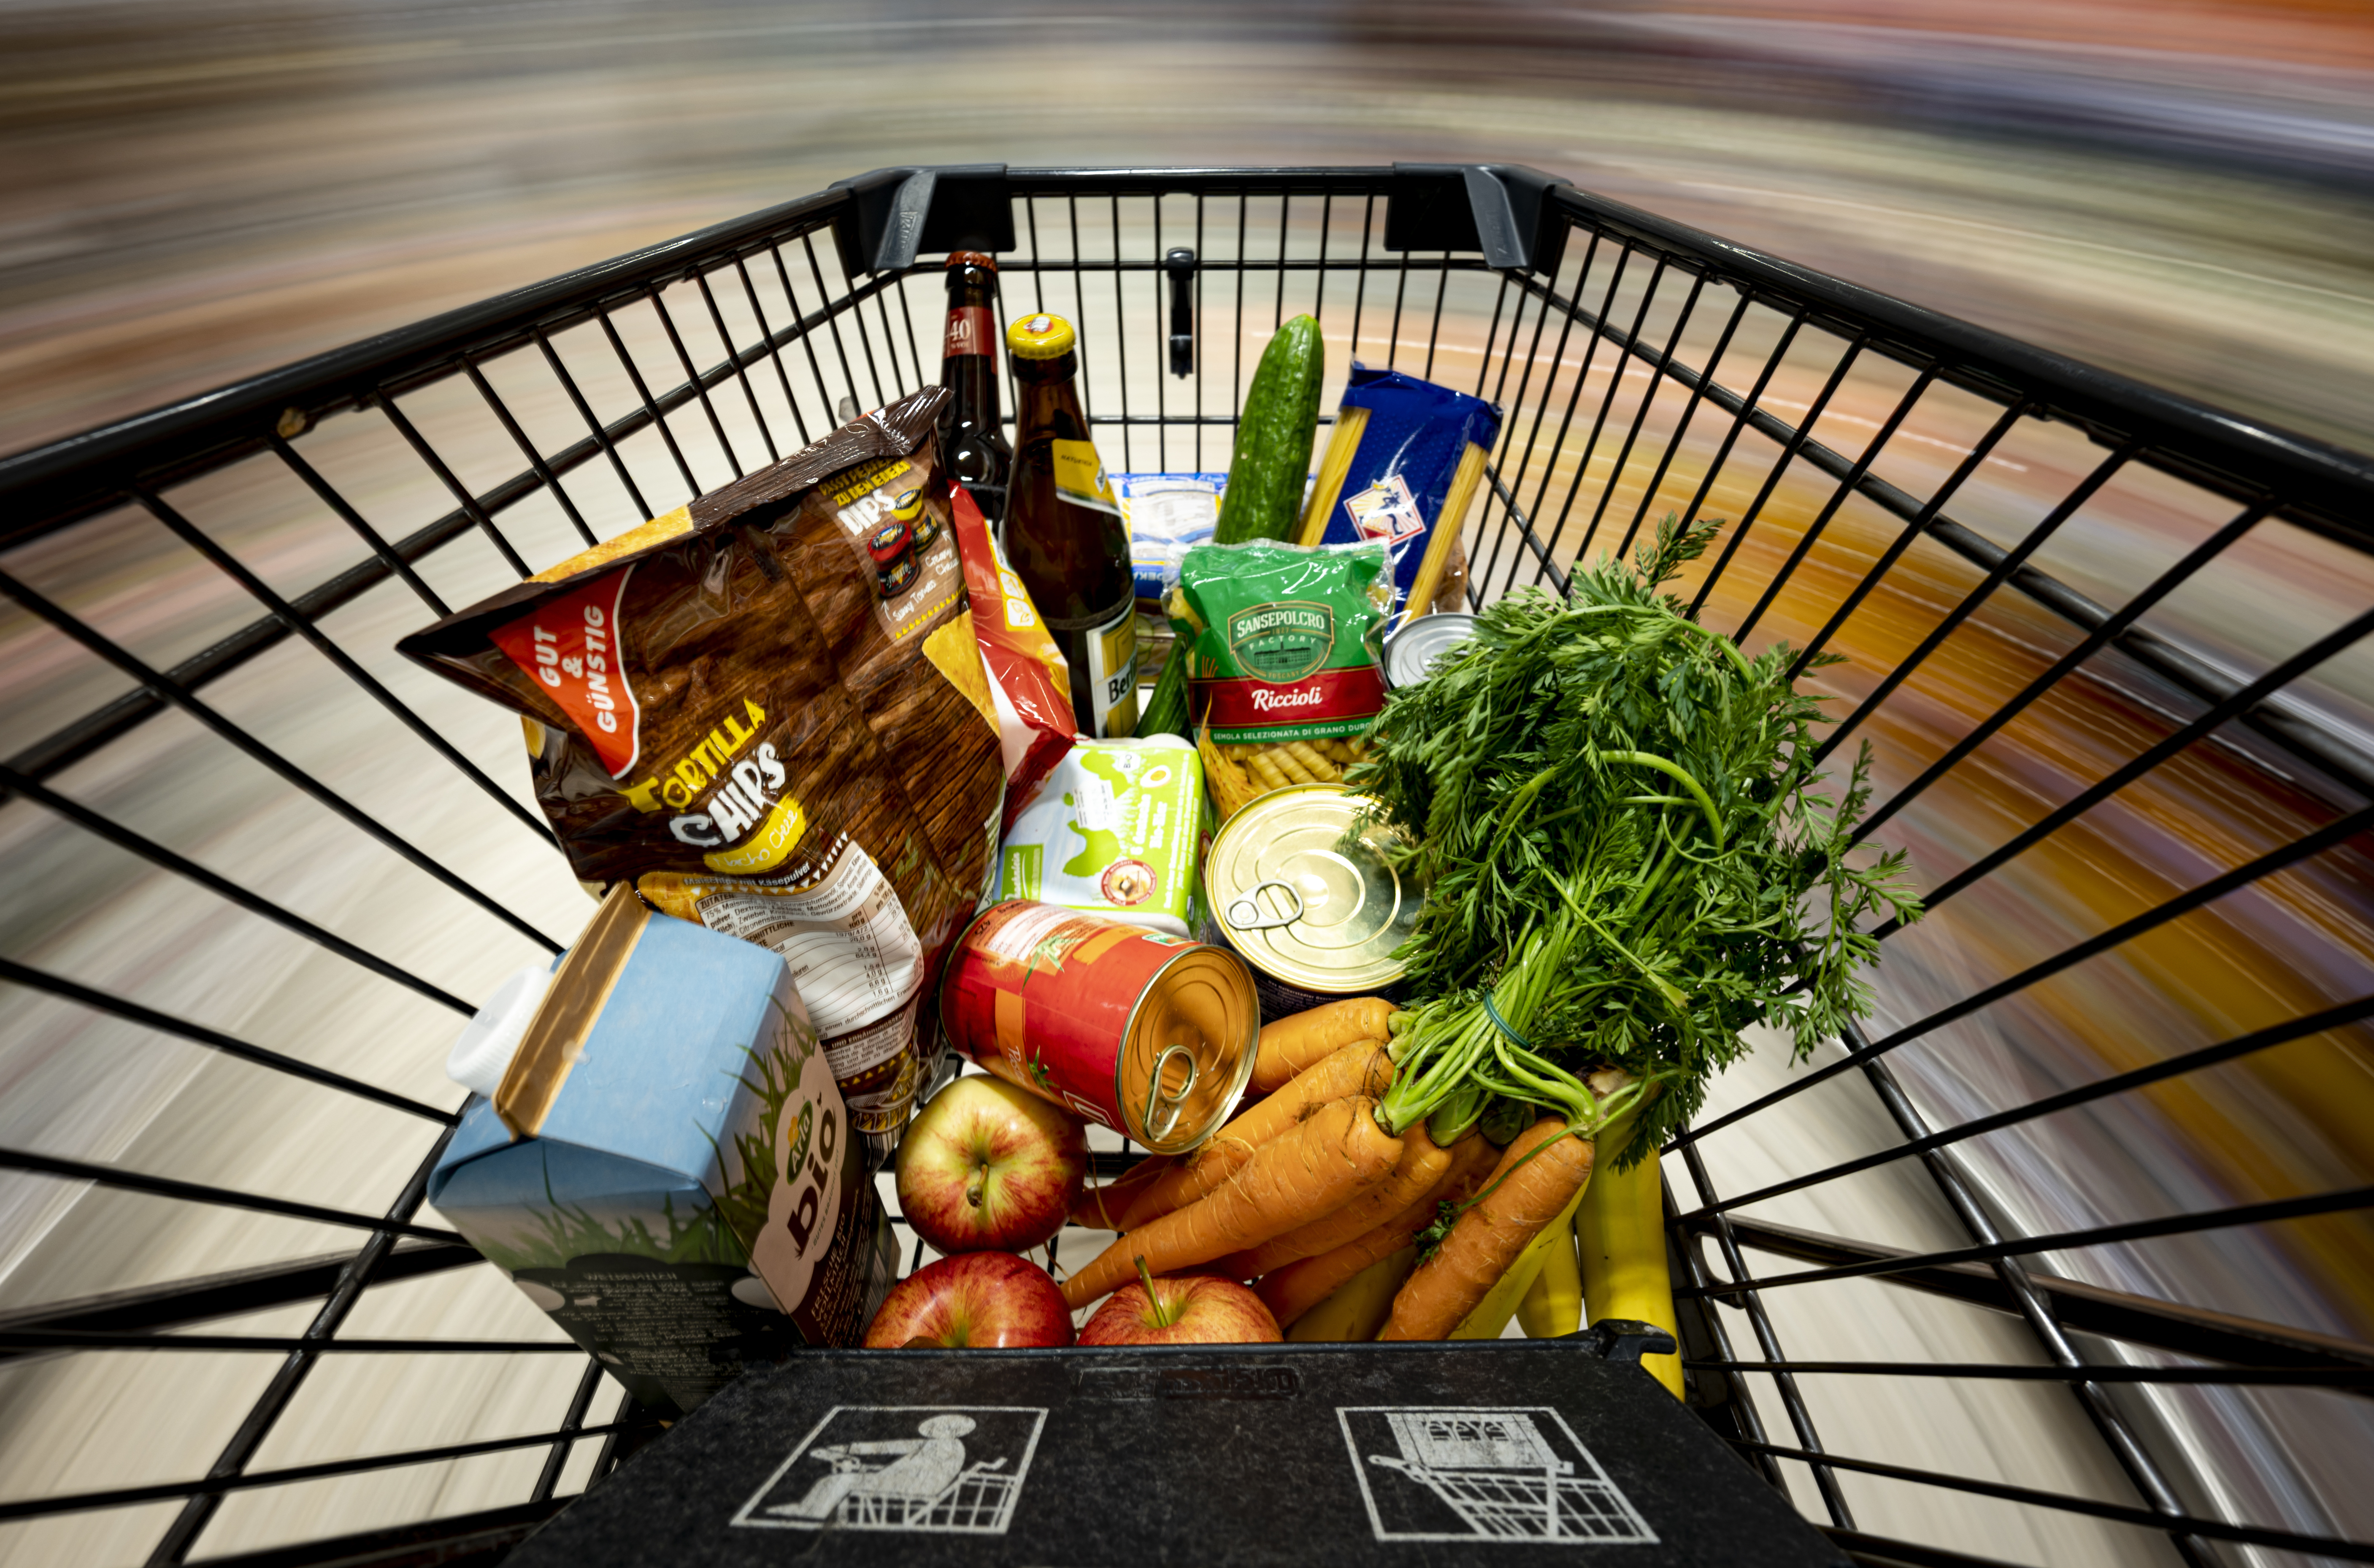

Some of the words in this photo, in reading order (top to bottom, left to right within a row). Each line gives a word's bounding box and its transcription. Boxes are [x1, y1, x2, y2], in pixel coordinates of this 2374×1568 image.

[949, 318, 971, 341] 40
[833, 492, 851, 507] ZU
[848, 480, 874, 500] DEN
[871, 460, 911, 487] EDEKA
[837, 488, 896, 536] DIPS
[1237, 610, 1325, 638] SANSEPOLCRO
[533, 624, 561, 687] GUT
[1249, 635, 1317, 650] FACTORY
[562, 656, 583, 679] &
[584, 605, 617, 733] GÜNSTIG
[1268, 669, 1301, 679] TUSCANY
[1251, 686, 1323, 712] Riccioli
[1213, 733, 1241, 741] SEMOLA
[1243, 729, 1299, 740] SELEZIONATA
[1314, 726, 1345, 735] GRANO
[617, 696, 765, 814] TORTILLA
[669, 741, 786, 847] CHIPS
[713, 848, 771, 867] Nacho
[684, 876, 737, 886] Maischips
[758, 860, 811, 886] Käsepulver
[738, 910, 768, 925] Zwiebel,
[848, 918, 859, 929] 100
[852, 911, 862, 922] pro
[866, 971, 876, 979] 4,0
[873, 989, 883, 998] 1,6
[825, 1021, 843, 1031] einen
[845, 995, 895, 1025] durchschnittlichen
[832, 1040, 847, 1049] UND
[867, 1035, 880, 1044] dem
[847, 1055, 859, 1064] und
[791, 1113, 810, 1174] Arla
[787, 1106, 837, 1260] bio
[813, 1217, 826, 1247] GUTES
[825, 1176, 836, 1217] BRAUCHT
[811, 1246, 838, 1317] FRISCHE
[836, 1212, 845, 1242] BIO
[815, 1233, 846, 1322] VOLLMILCH
